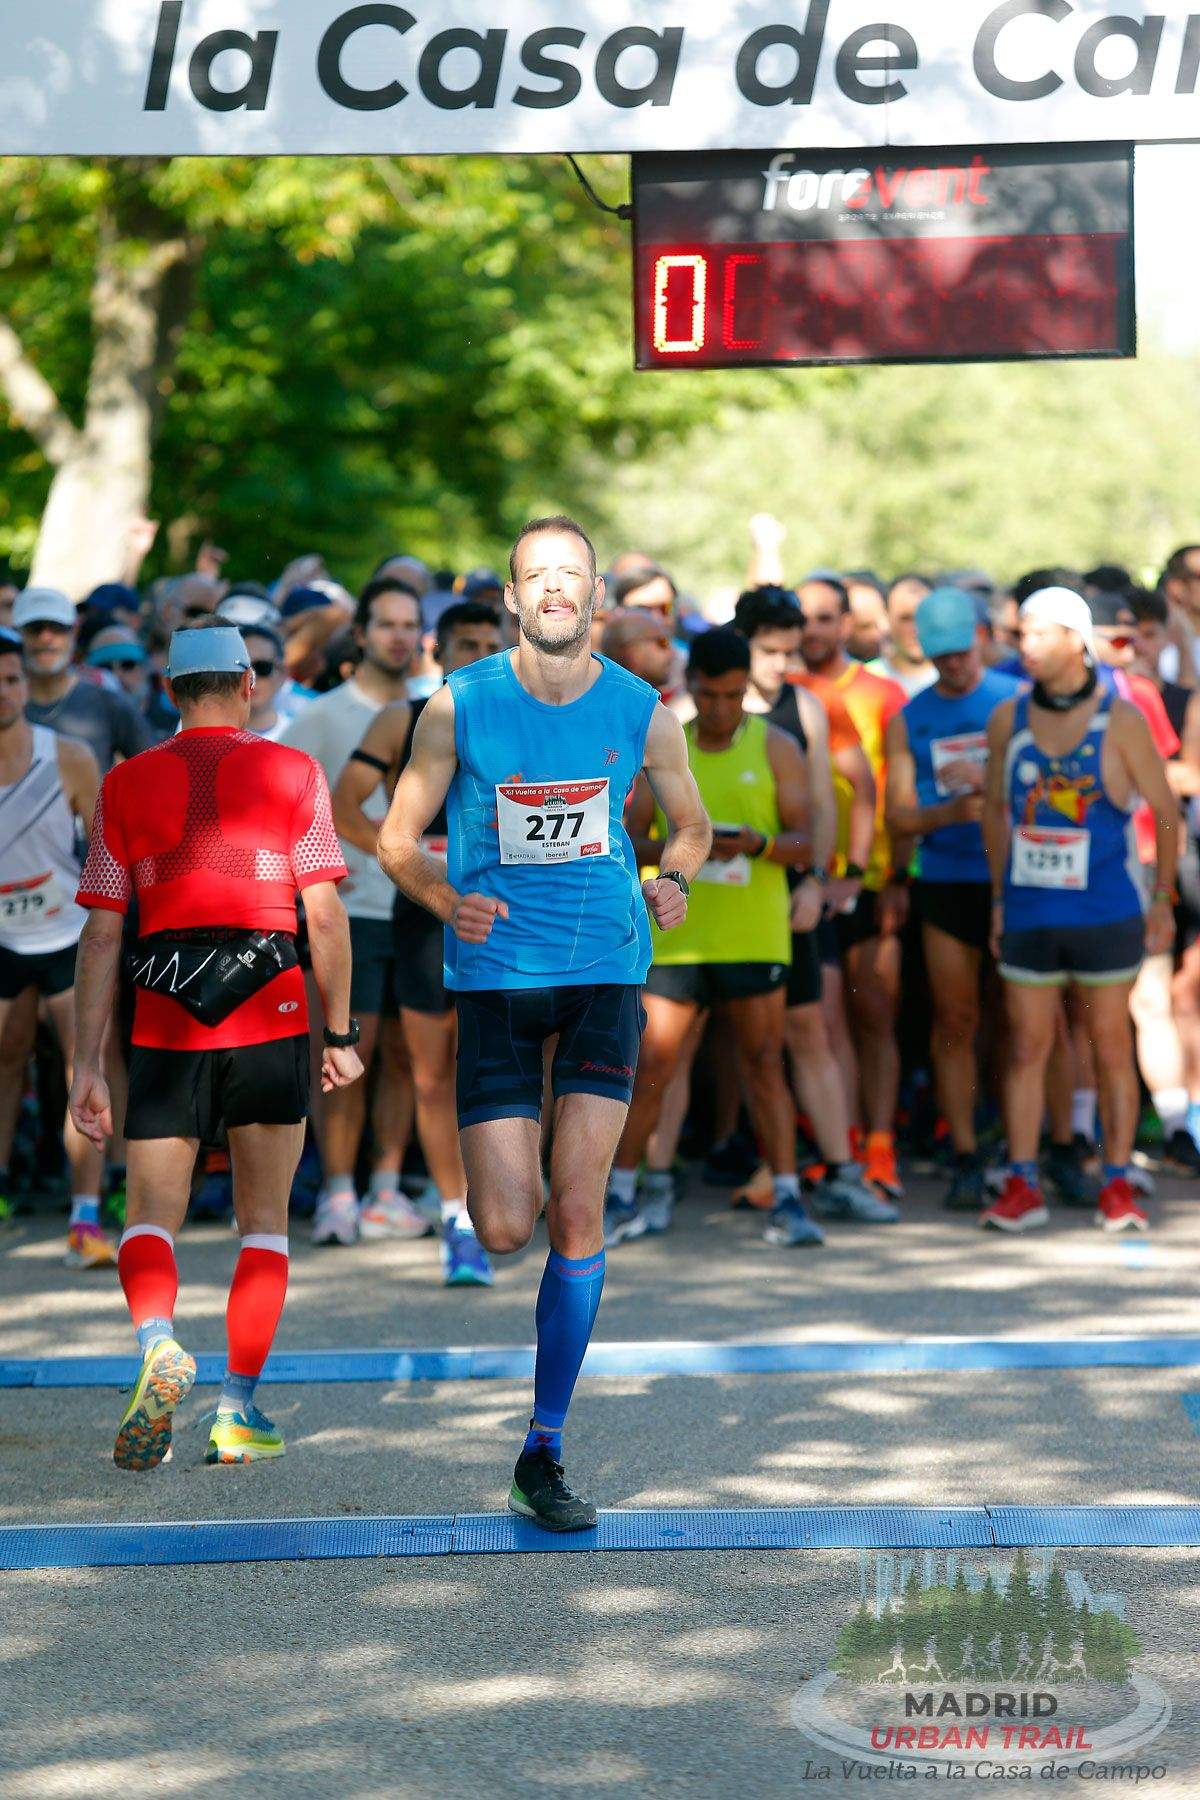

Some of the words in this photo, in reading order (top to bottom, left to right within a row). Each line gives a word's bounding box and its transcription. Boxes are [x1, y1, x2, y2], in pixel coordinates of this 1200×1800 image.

[143, 0, 279, 112] la
[317, 3, 685, 112] Casa
[736, 0, 919, 106] de
[761, 152, 992, 211] forevent
[553, 787, 570, 795] Casa
[525, 811, 585, 841] 277
[1024, 850, 1074, 870] 1291
